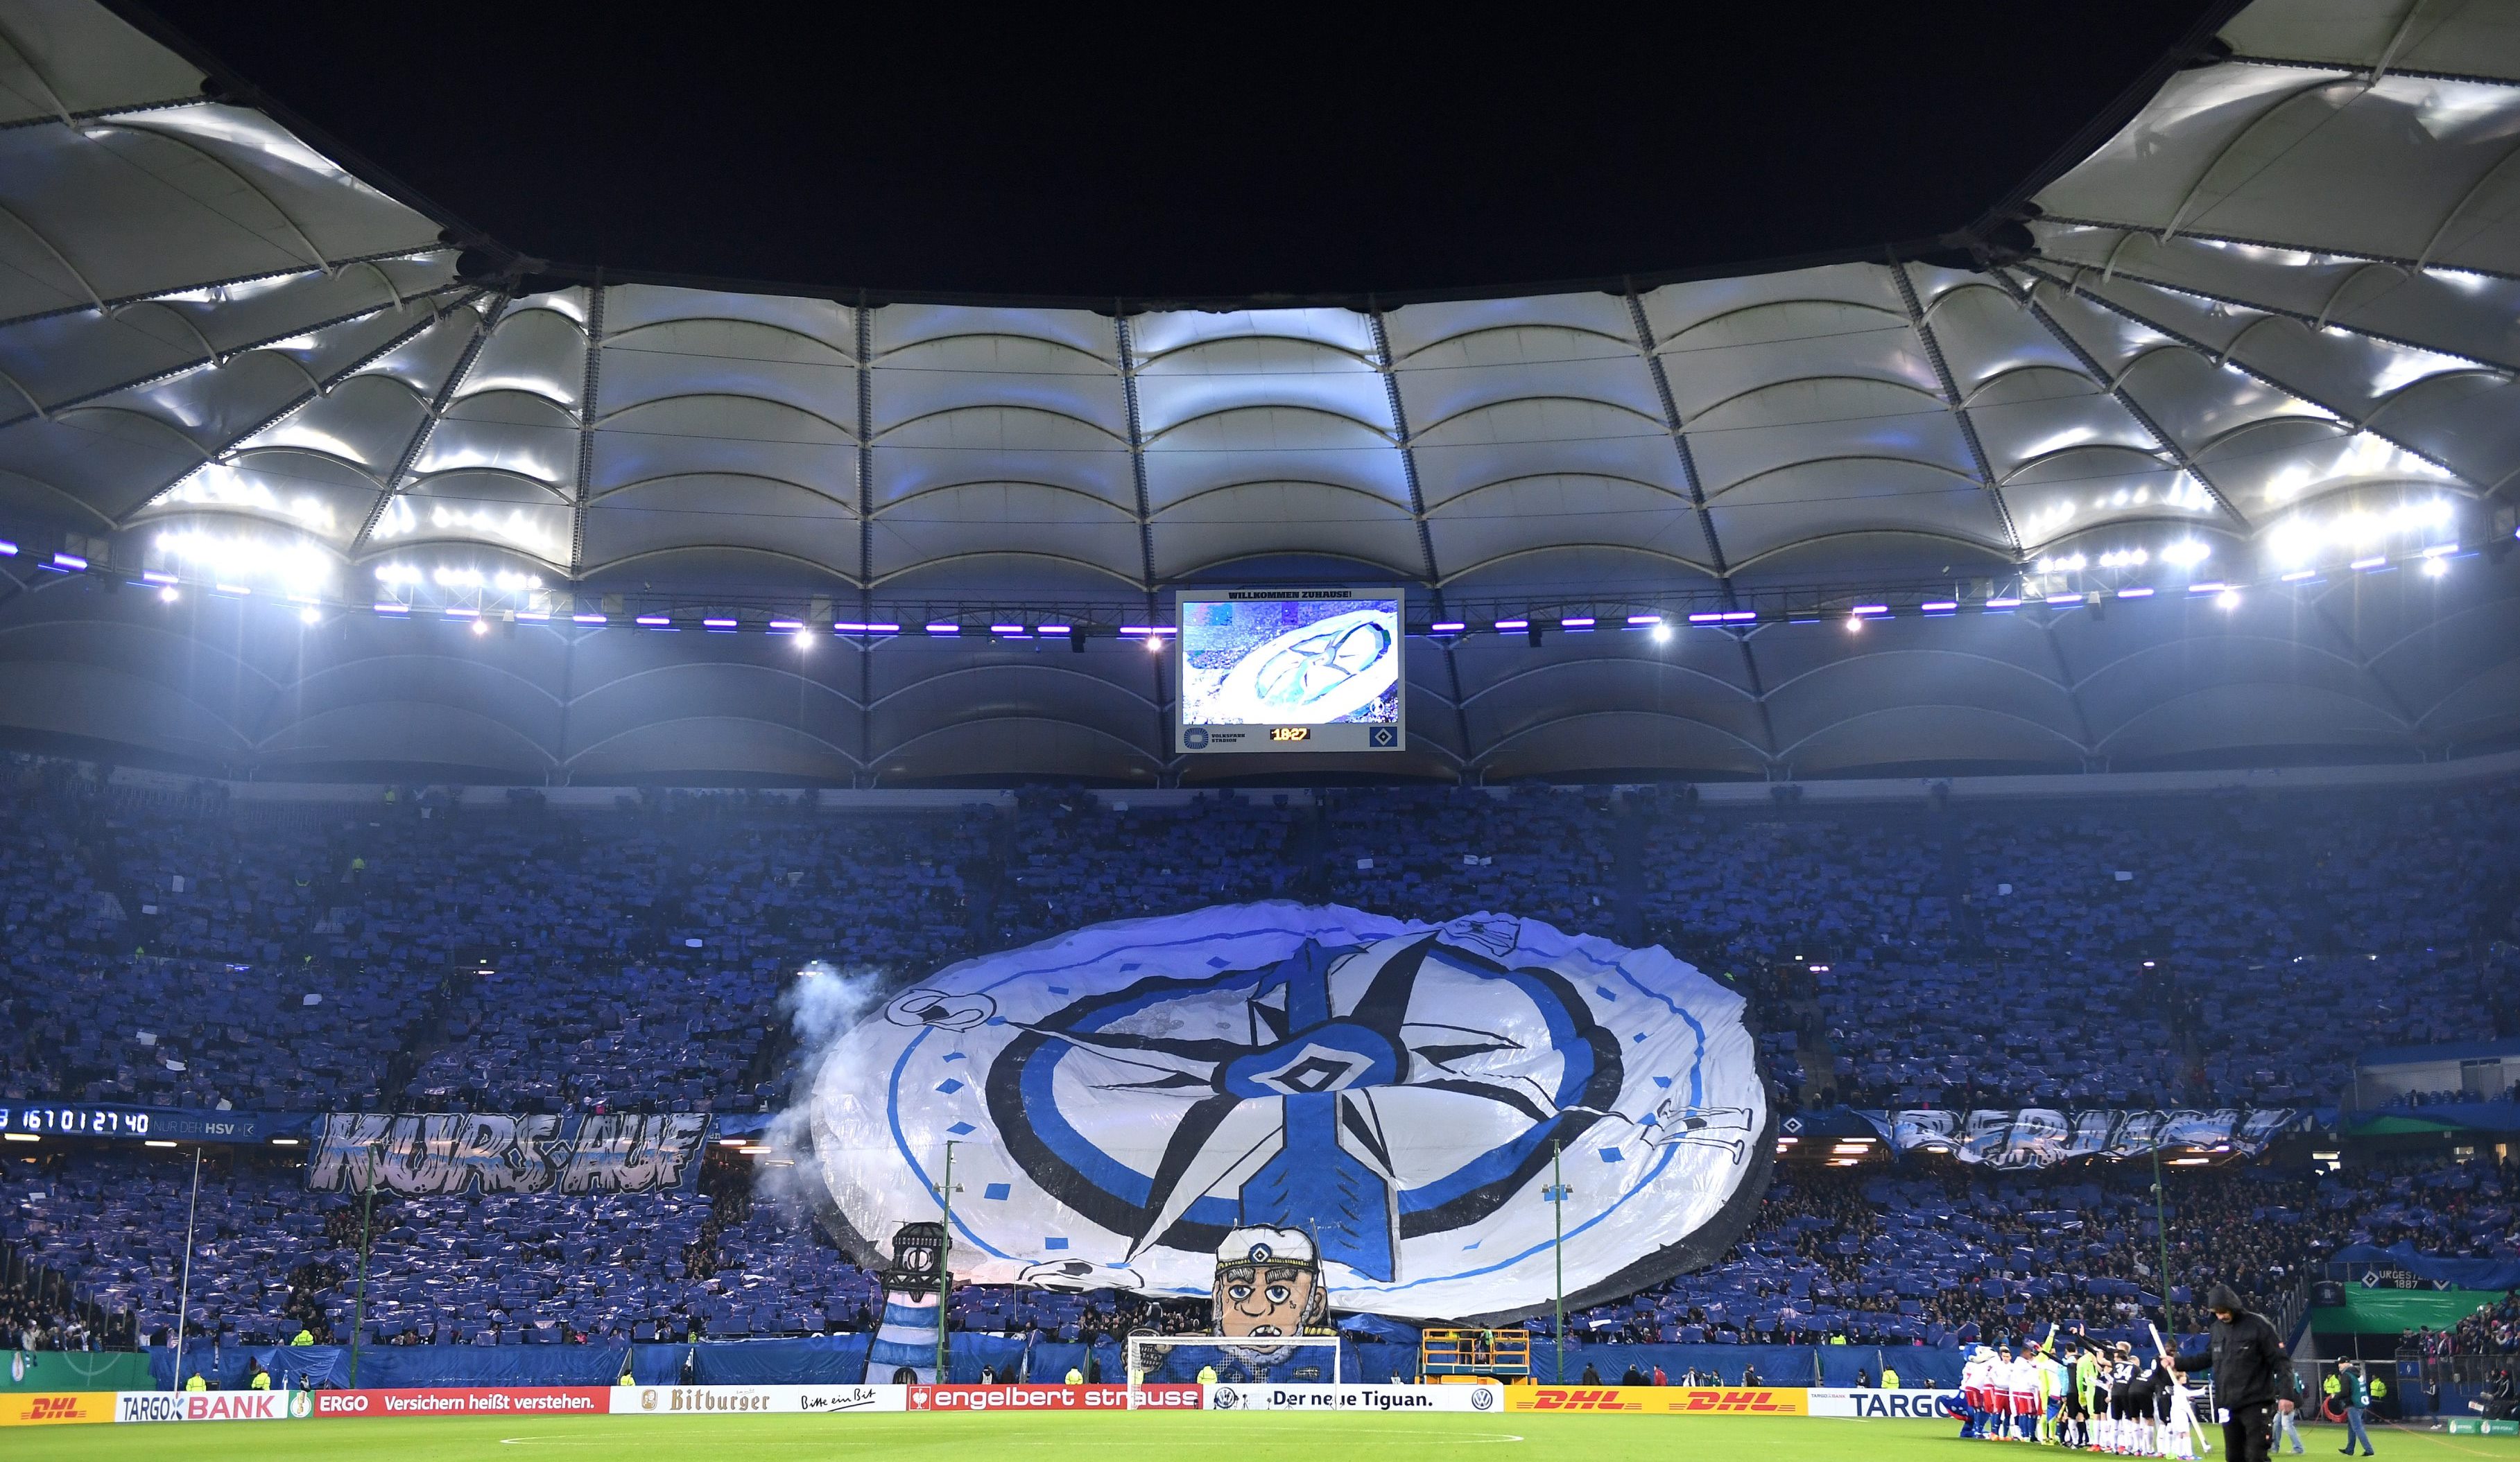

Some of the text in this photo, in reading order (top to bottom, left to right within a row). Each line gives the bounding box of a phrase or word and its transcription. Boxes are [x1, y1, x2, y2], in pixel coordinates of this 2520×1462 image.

[153, 1120, 234, 1135] NUR DER HSV
[305, 1111, 711, 1198] KURS AUF
[2394, 1279, 2418, 1289] 1887
[2114, 1363, 2133, 1381] 34
[187, 1395, 275, 1419] BANK
[320, 1395, 368, 1411] ERGO
[384, 1393, 594, 1411] Versichern heißt verstehen.
[669, 1389, 770, 1411] Bitburger
[801, 1388, 876, 1409] Bitte ein Bit
[935, 1387, 1198, 1410] engelbert strauss
[1275, 1391, 1306, 1405] Der
[1362, 1391, 1433, 1410] Tiguan.
[1534, 1391, 1625, 1409] DHL
[1686, 1391, 1778, 1411] DHL
[31, 1398, 79, 1419] DHL
